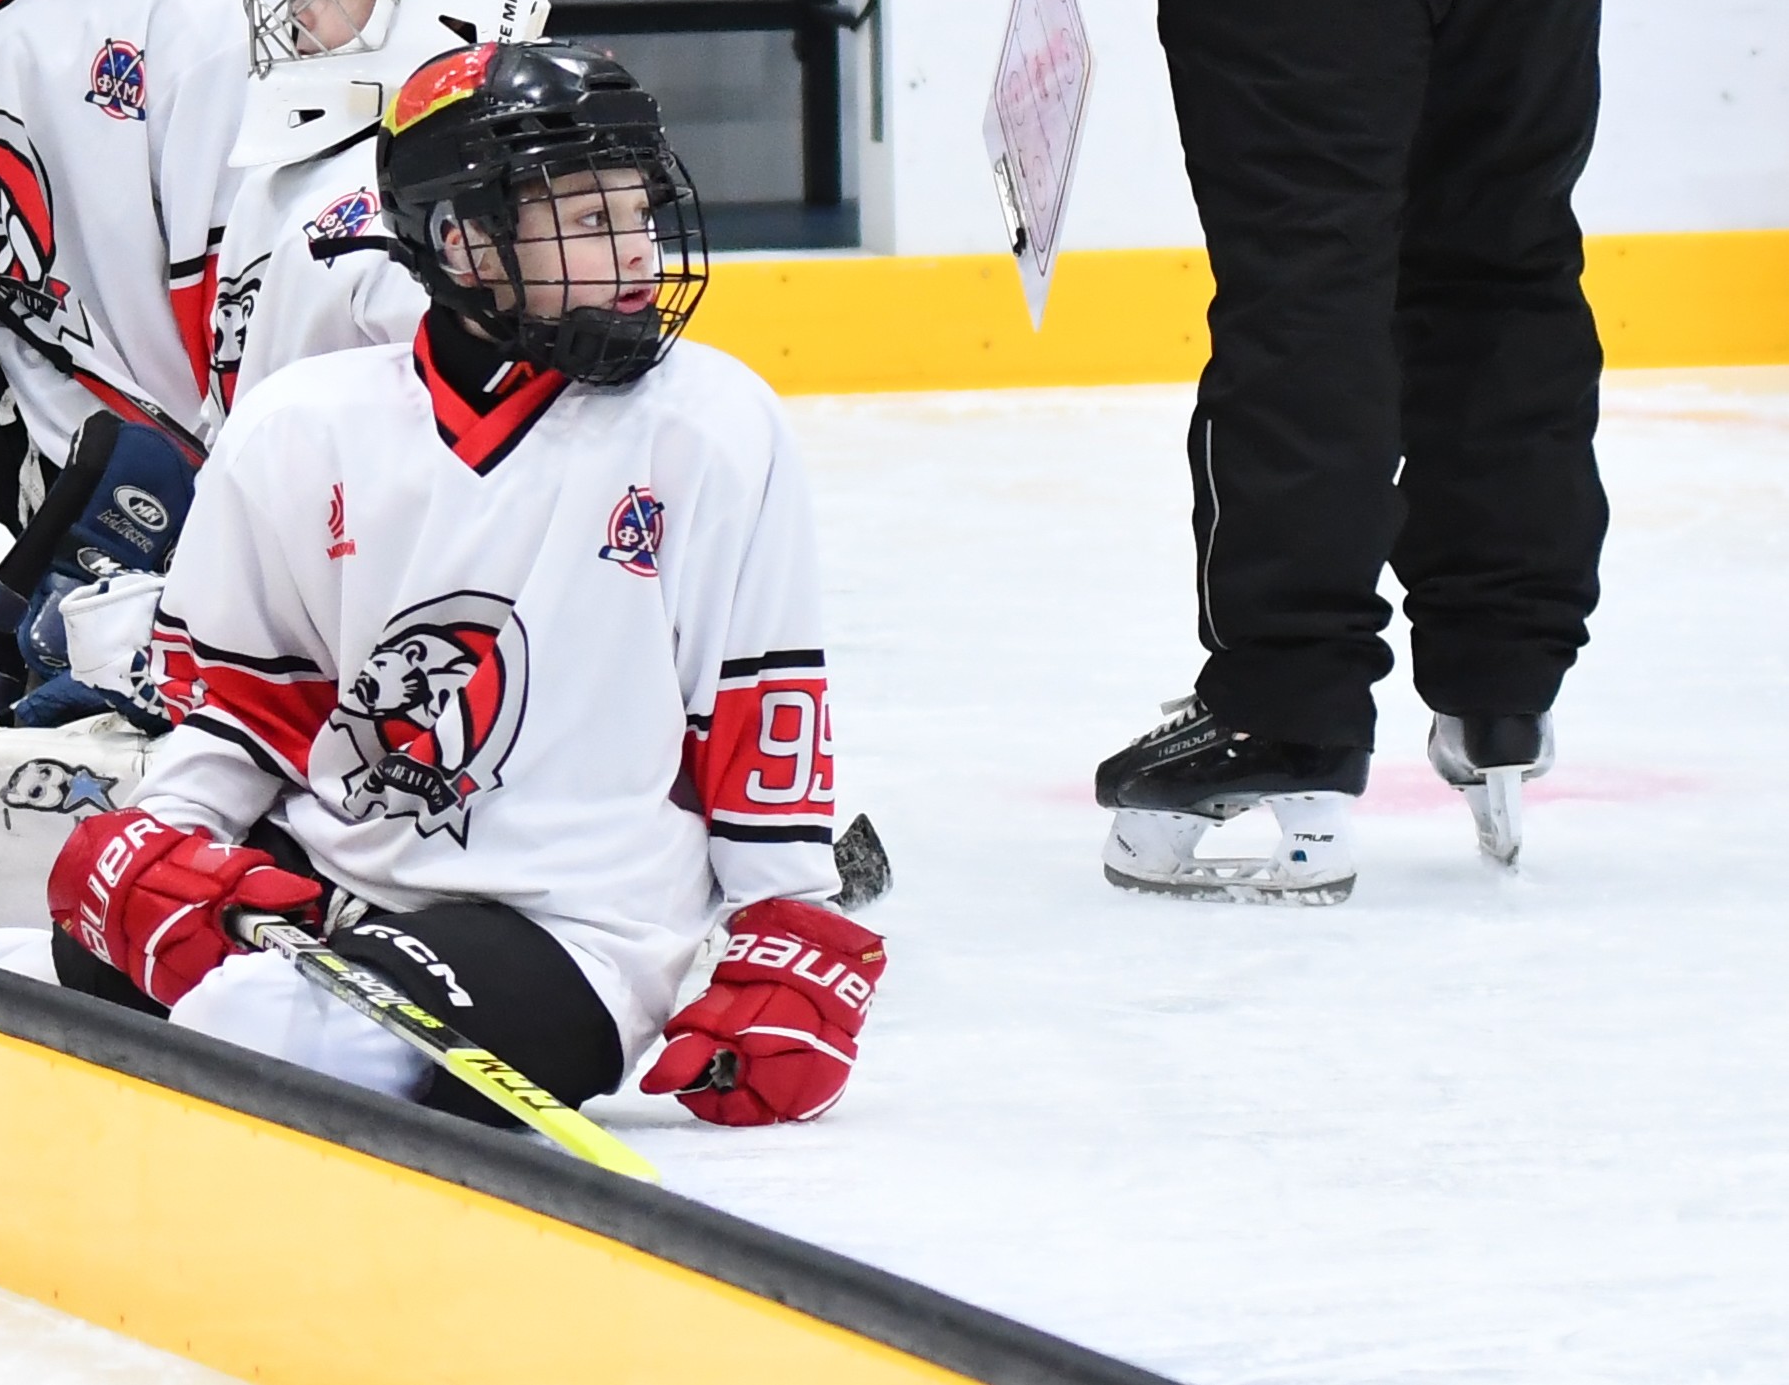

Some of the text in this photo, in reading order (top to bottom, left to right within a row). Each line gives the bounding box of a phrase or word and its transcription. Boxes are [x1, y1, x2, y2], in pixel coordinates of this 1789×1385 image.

[97, 73, 139, 104] ФХМ
[617, 525, 655, 553] ФХ
[1293, 832, 1335, 843] TRUE
[723, 932, 877, 1016] BAUE
